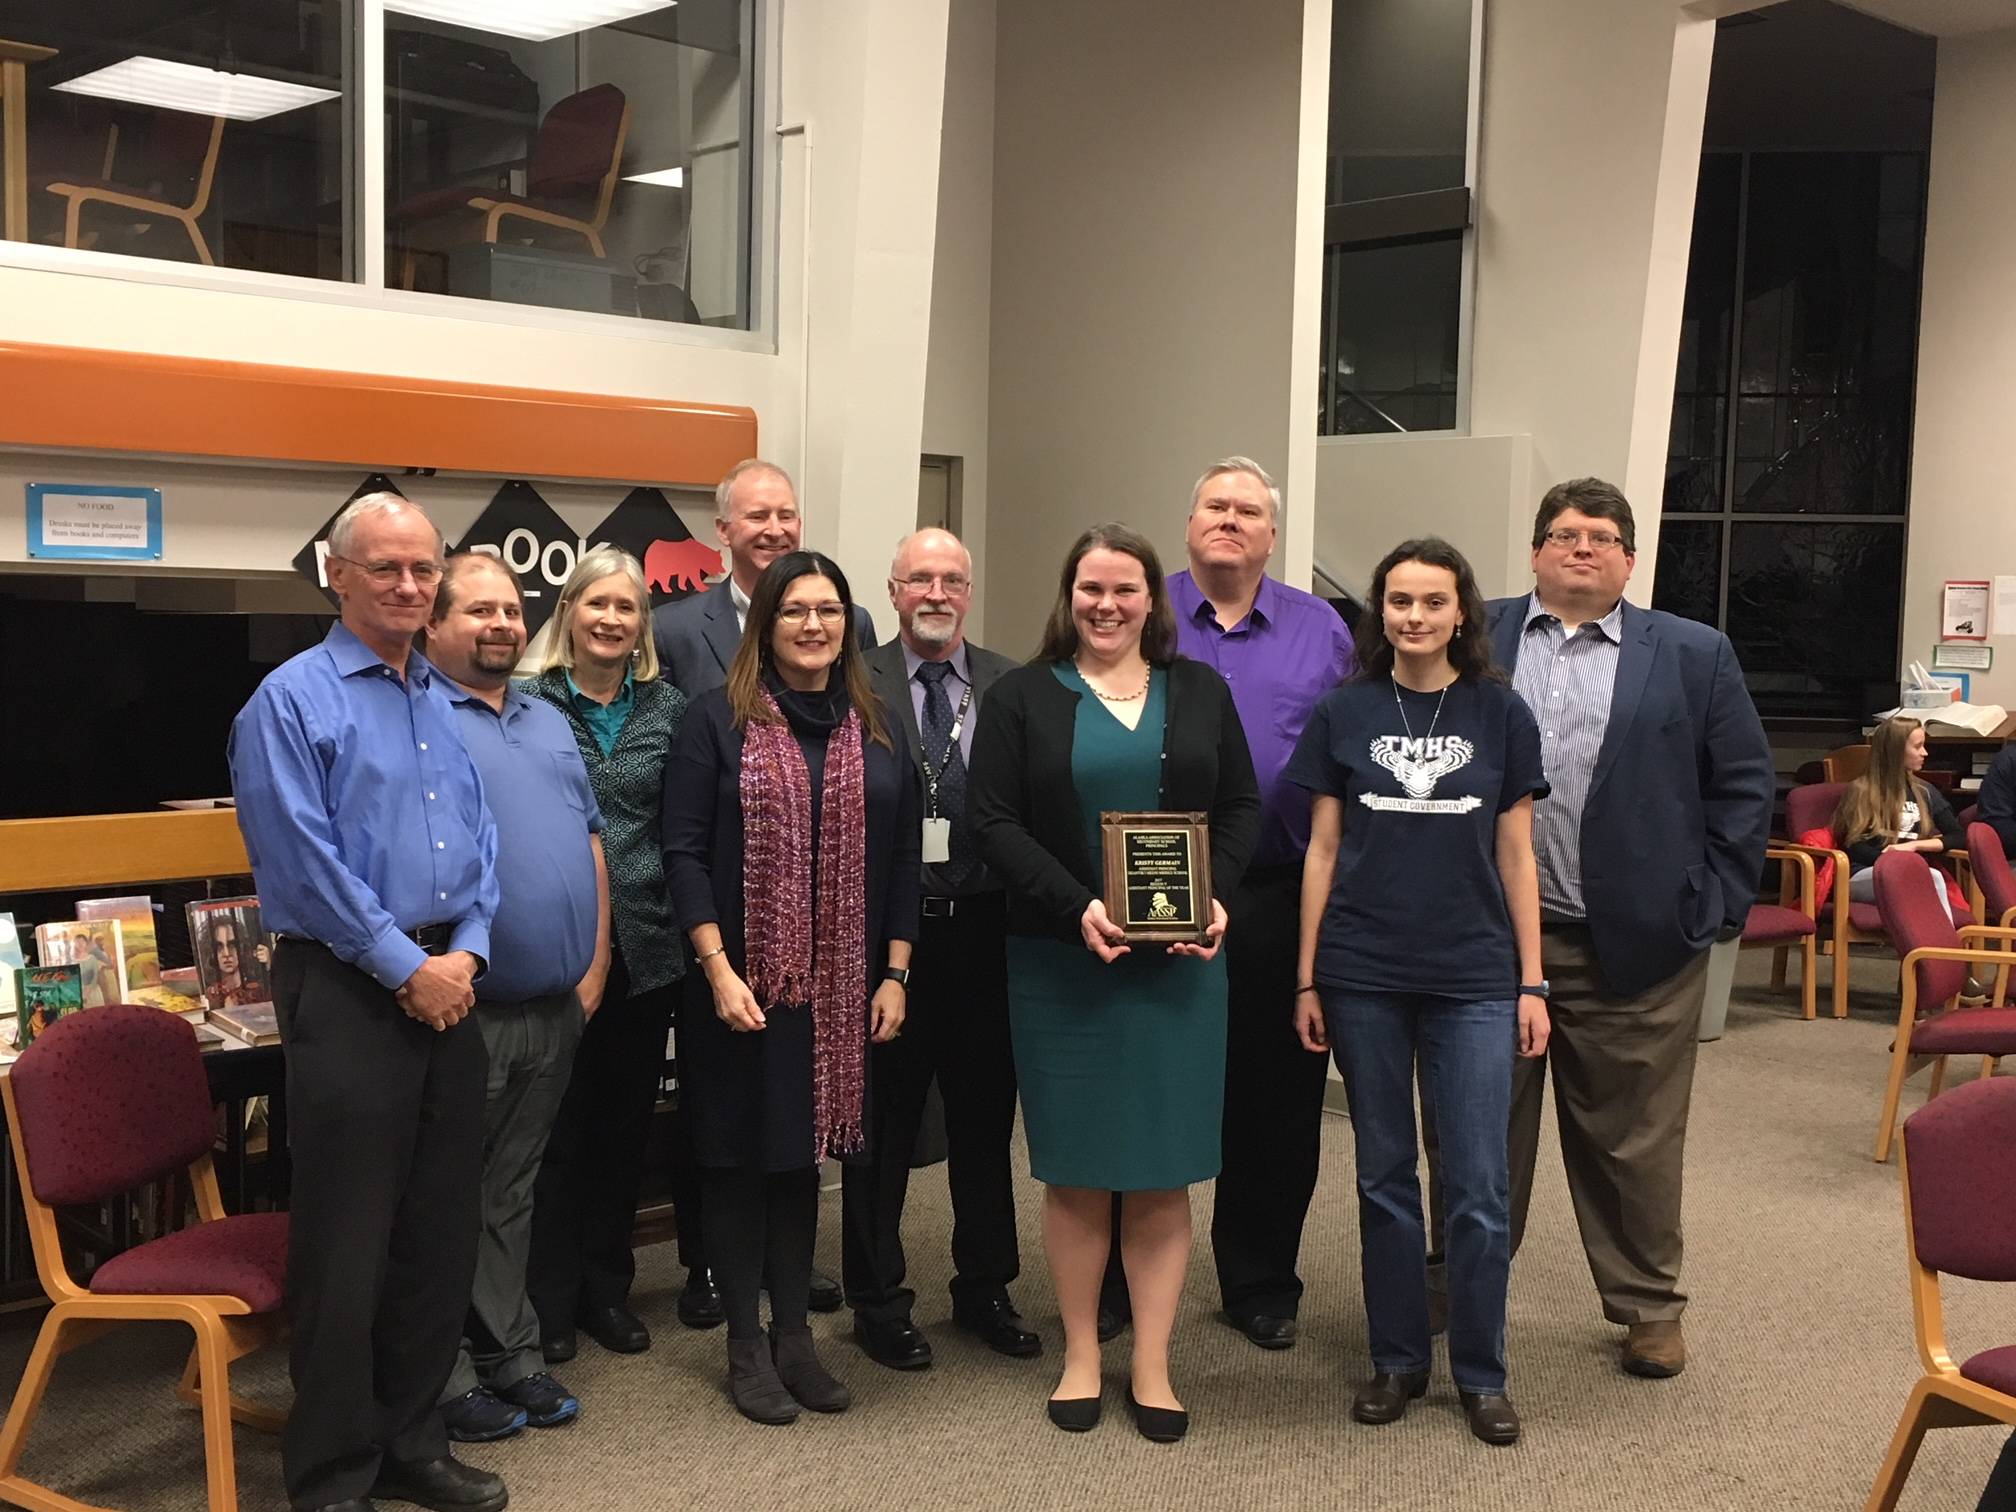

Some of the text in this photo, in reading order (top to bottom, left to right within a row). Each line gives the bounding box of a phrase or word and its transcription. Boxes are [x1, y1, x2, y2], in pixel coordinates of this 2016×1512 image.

[77, 502, 114, 511] NO FOOD
[92, 521, 100, 529] be
[101, 522, 123, 531] placed
[124, 524, 142, 532] away
[70, 530, 90, 538] books
[1380, 735, 1463, 759] TMHS
[1373, 799, 1465, 813] STUDENT GOVERNMENT
